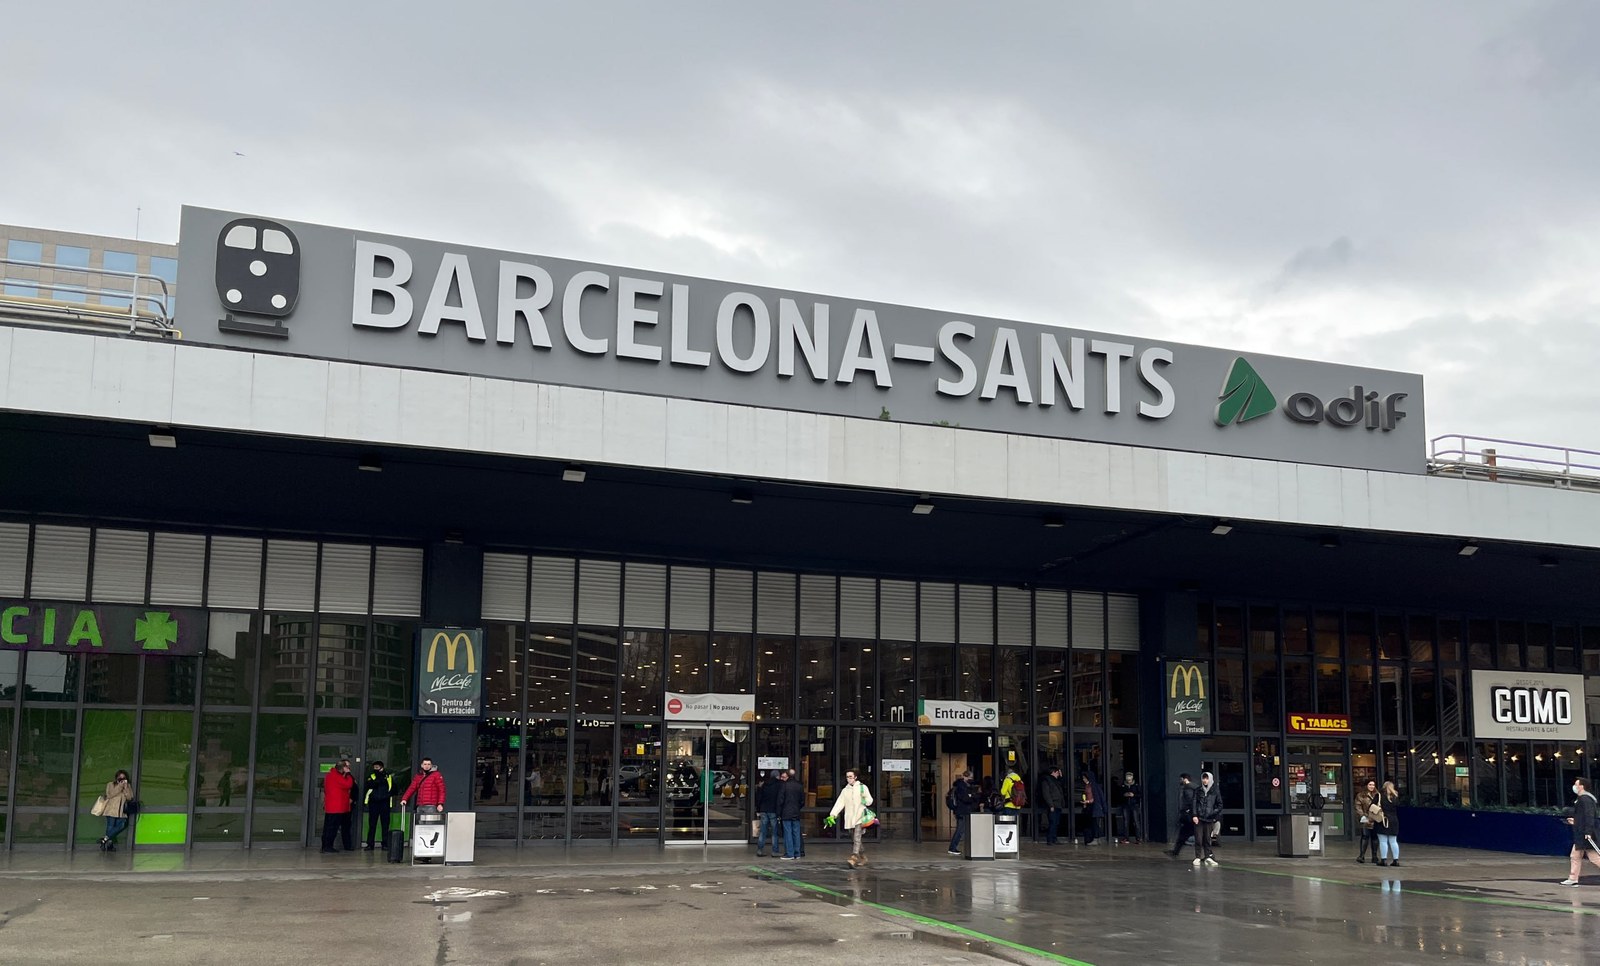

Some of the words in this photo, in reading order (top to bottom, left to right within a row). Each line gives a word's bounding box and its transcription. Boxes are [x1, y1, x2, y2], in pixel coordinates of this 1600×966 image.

[351, 239, 1176, 420] BARCELONA-SANTS
[1283, 385, 1408, 431] adif
[1, 606, 103, 647] CIA
[441, 698, 463, 707] Dentro
[464, 699, 472, 707] de
[441, 706, 448, 714] la
[449, 706, 476, 715] estación
[935, 707, 980, 720] Entrada
[1491, 686, 1572, 725] COMO
[1307, 718, 1348, 728] TABACS
